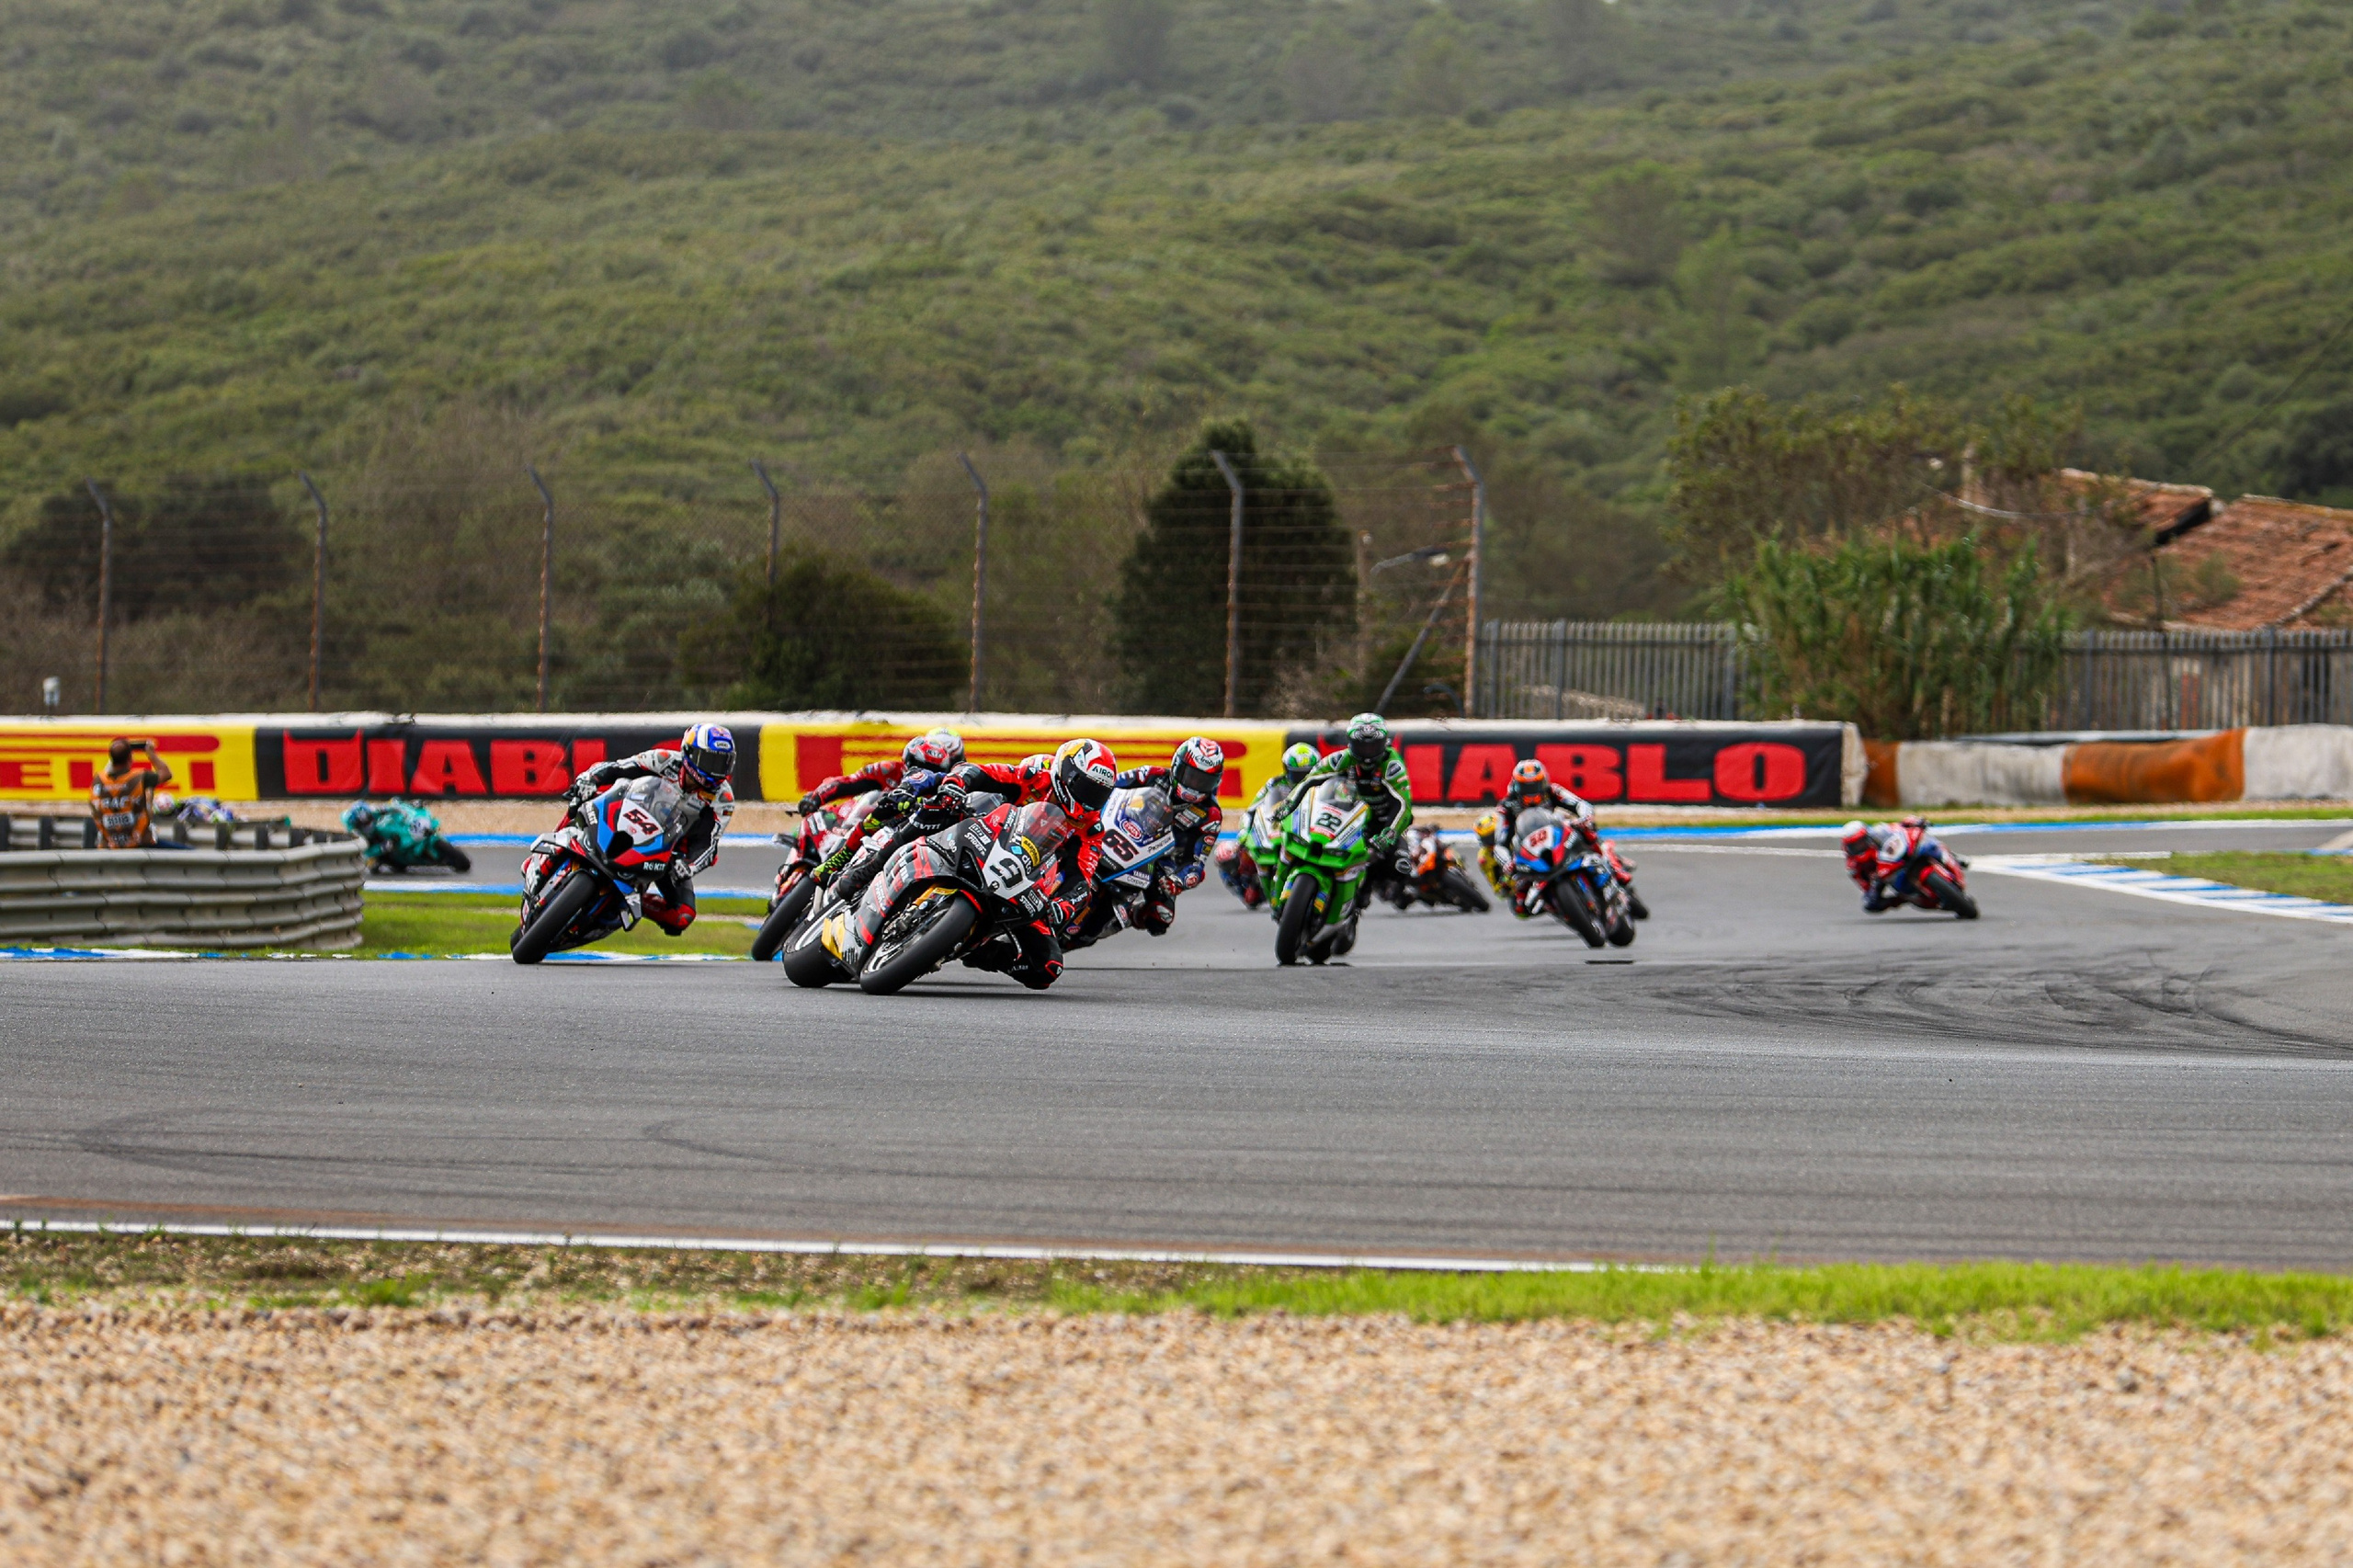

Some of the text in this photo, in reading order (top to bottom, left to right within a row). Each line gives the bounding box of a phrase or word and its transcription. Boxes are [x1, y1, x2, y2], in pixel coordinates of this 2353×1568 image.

[622, 809, 659, 835] 54
[1315, 812, 1342, 833] 22
[1102, 828, 1140, 862] 65
